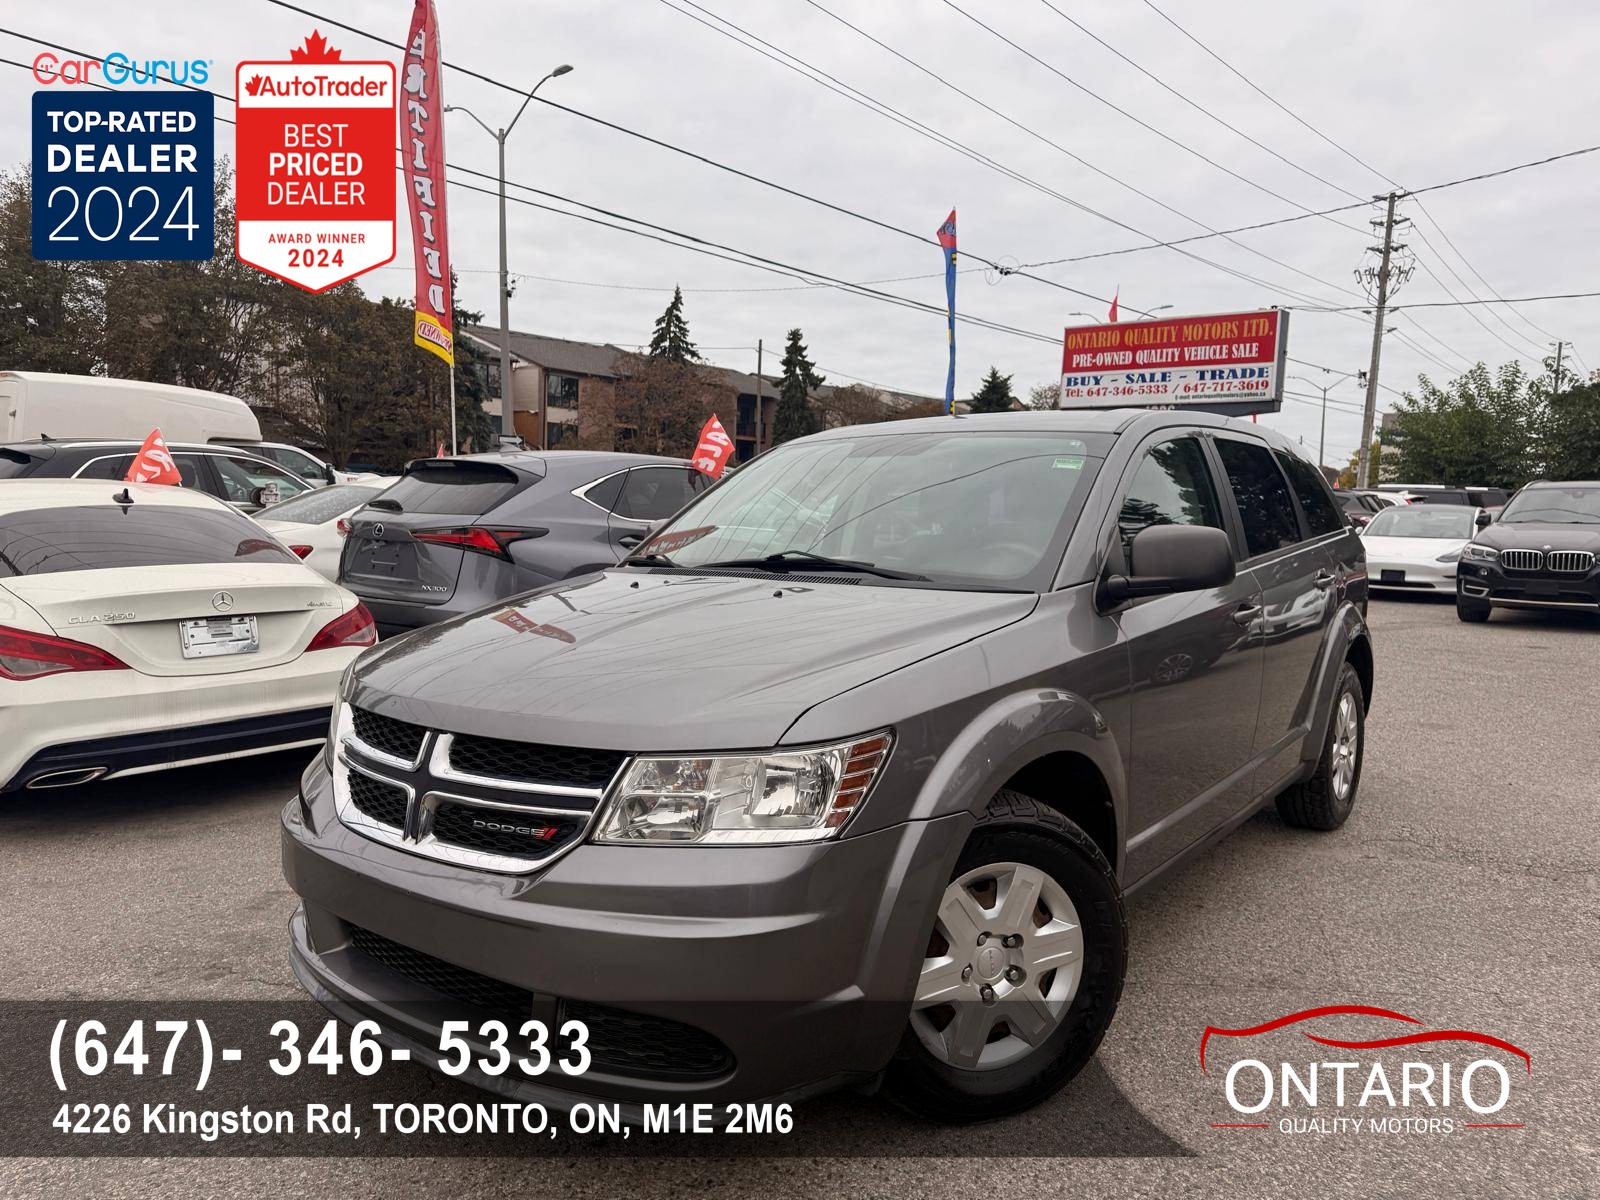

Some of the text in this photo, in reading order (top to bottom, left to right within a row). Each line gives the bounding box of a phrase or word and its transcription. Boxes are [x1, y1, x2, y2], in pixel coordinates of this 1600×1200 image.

[1067, 318, 1274, 350] ONTARIO QUALITY MOTORS LTD.
[1072, 342, 1259, 368] PRE-OWNED QUALITY VEHICLE SALE
[1066, 375, 1104, 387] BUY
[1125, 371, 1173, 384] SALE
[1196, 367, 1270, 381] TRADE
[1065, 388, 1084, 397] Tel:
[1087, 384, 1168, 397] 647-346-5333
[1183, 379, 1269, 393] 647-717-3619
[68, 615, 102, 625] CLA
[472, 819, 546, 837] DODGE
